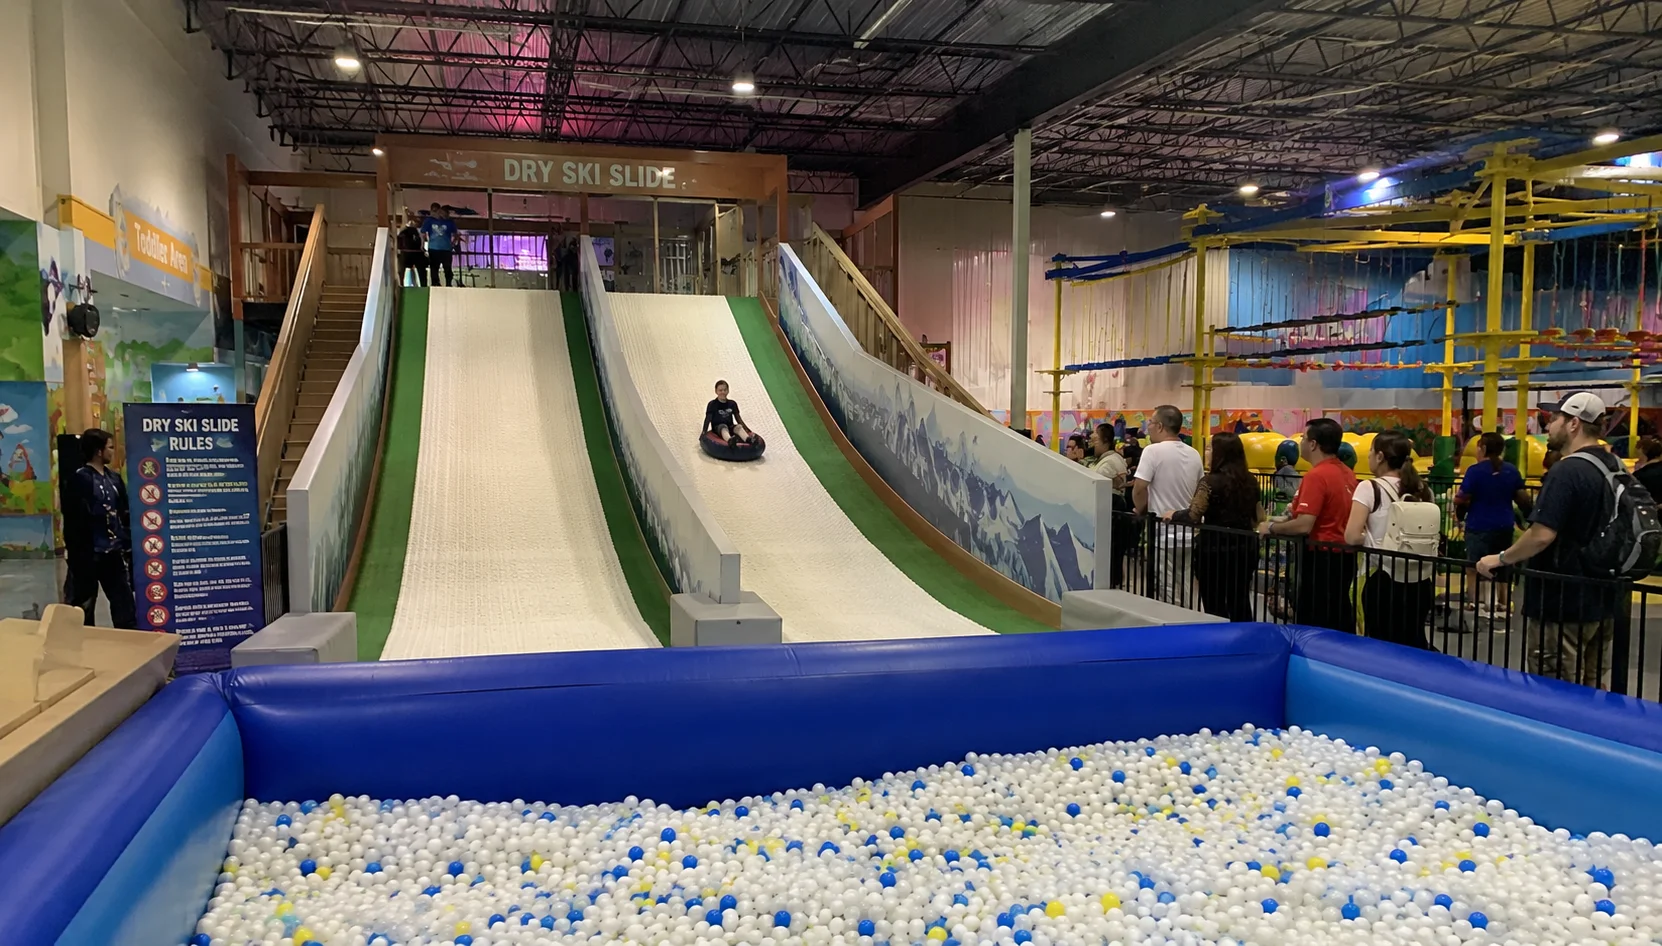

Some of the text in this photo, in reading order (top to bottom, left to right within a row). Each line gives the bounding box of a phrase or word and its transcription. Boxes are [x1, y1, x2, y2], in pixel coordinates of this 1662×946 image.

[504, 158, 676, 189] DRY SKI SLIDE
[142, 418, 239, 432] DRY SKI SLIDE
[169, 436, 213, 451] RULES
